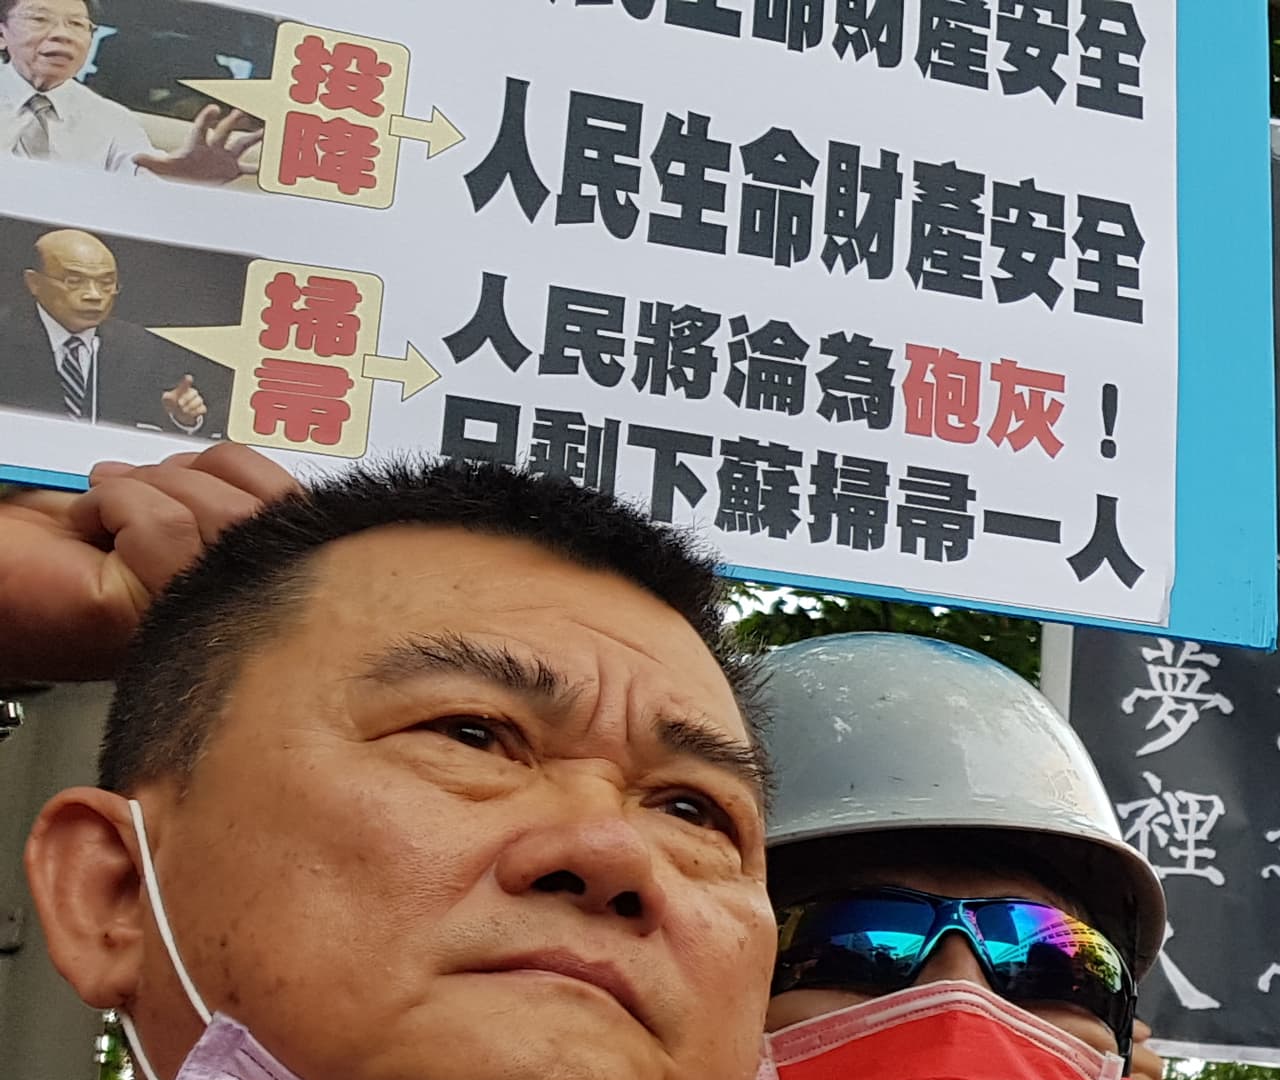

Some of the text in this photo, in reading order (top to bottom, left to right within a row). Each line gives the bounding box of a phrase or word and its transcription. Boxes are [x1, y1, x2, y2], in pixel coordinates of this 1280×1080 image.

[278, 36, 391, 194] 投降
[464, 77, 1145, 324] 人民生命財產安全
[251, 272, 361, 445] 掃帚
